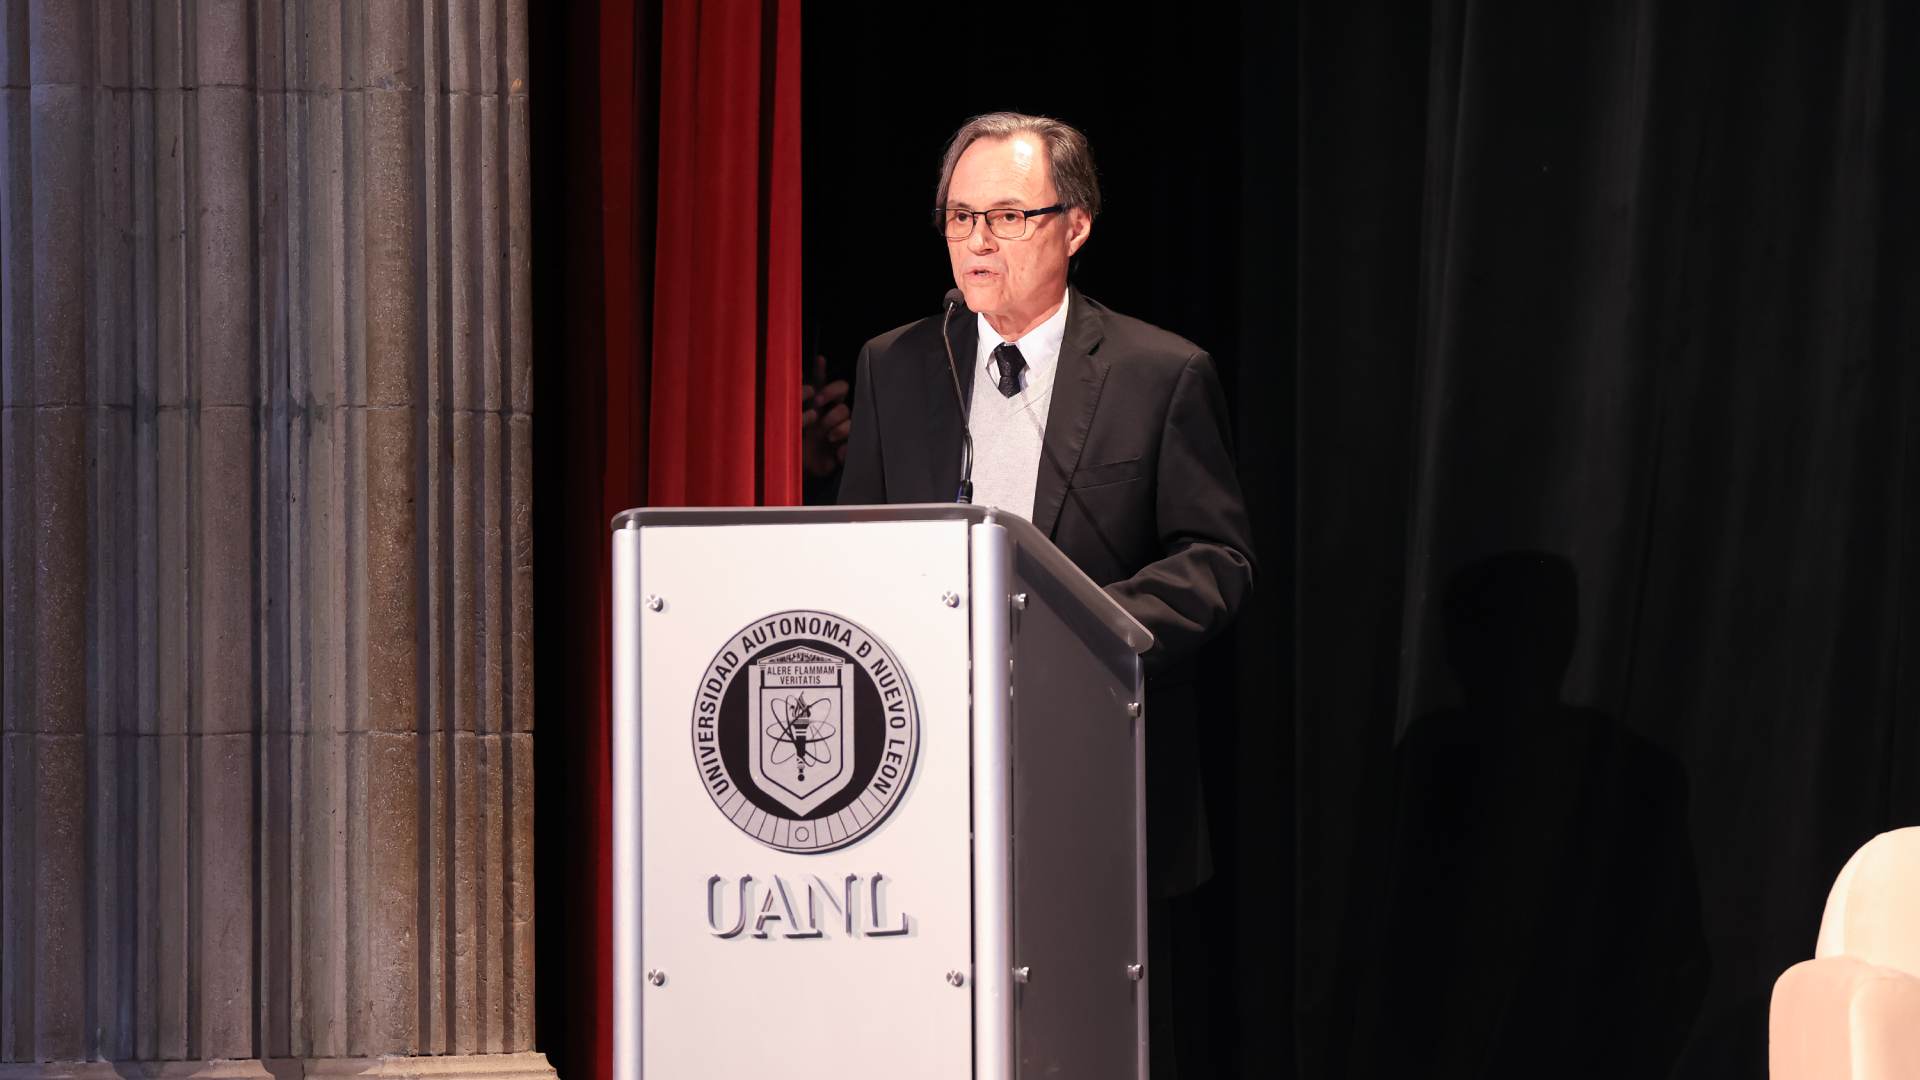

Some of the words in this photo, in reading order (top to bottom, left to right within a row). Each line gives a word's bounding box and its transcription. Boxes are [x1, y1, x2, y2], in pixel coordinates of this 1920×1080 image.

[741, 616, 853, 654] AUTONOMA
[767, 665, 792, 676] ALERE
[794, 665, 836, 675] FLAMMAM
[779, 675, 822, 685] VERITATIS
[870, 658, 907, 730] NUEVO
[698, 650, 740, 796] UNIVERSIDAD
[873, 738, 905, 796] LEON
[706, 872, 910, 940] UANL
